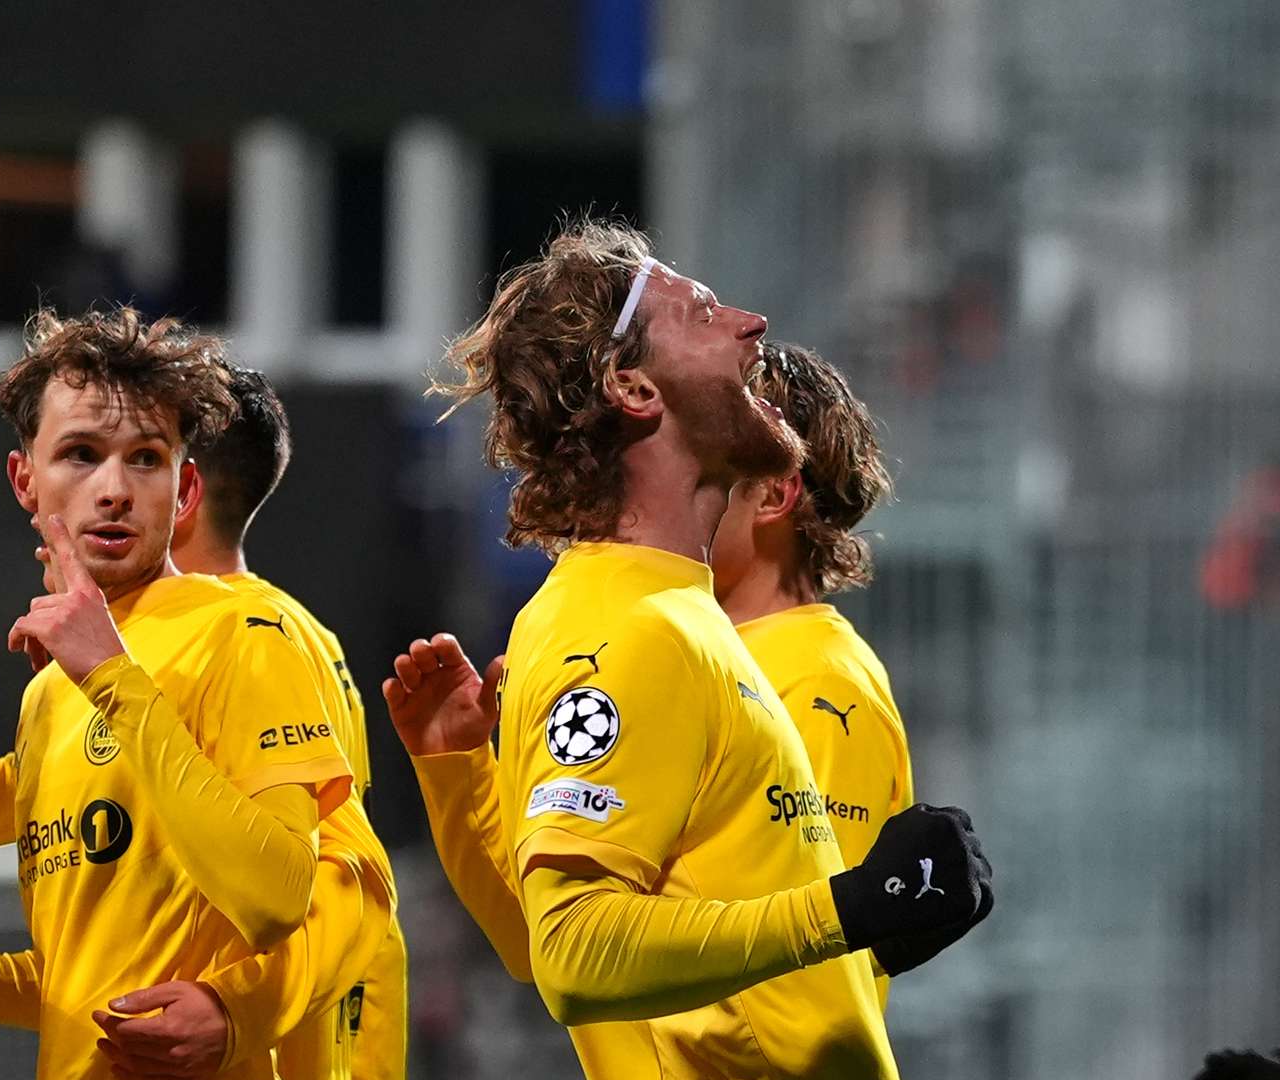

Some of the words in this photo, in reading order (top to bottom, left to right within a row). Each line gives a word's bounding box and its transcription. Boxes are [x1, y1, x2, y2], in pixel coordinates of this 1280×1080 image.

[281, 722, 331, 746] Elke
[825, 794, 870, 824] kem
[16, 807, 75, 863] eBank
